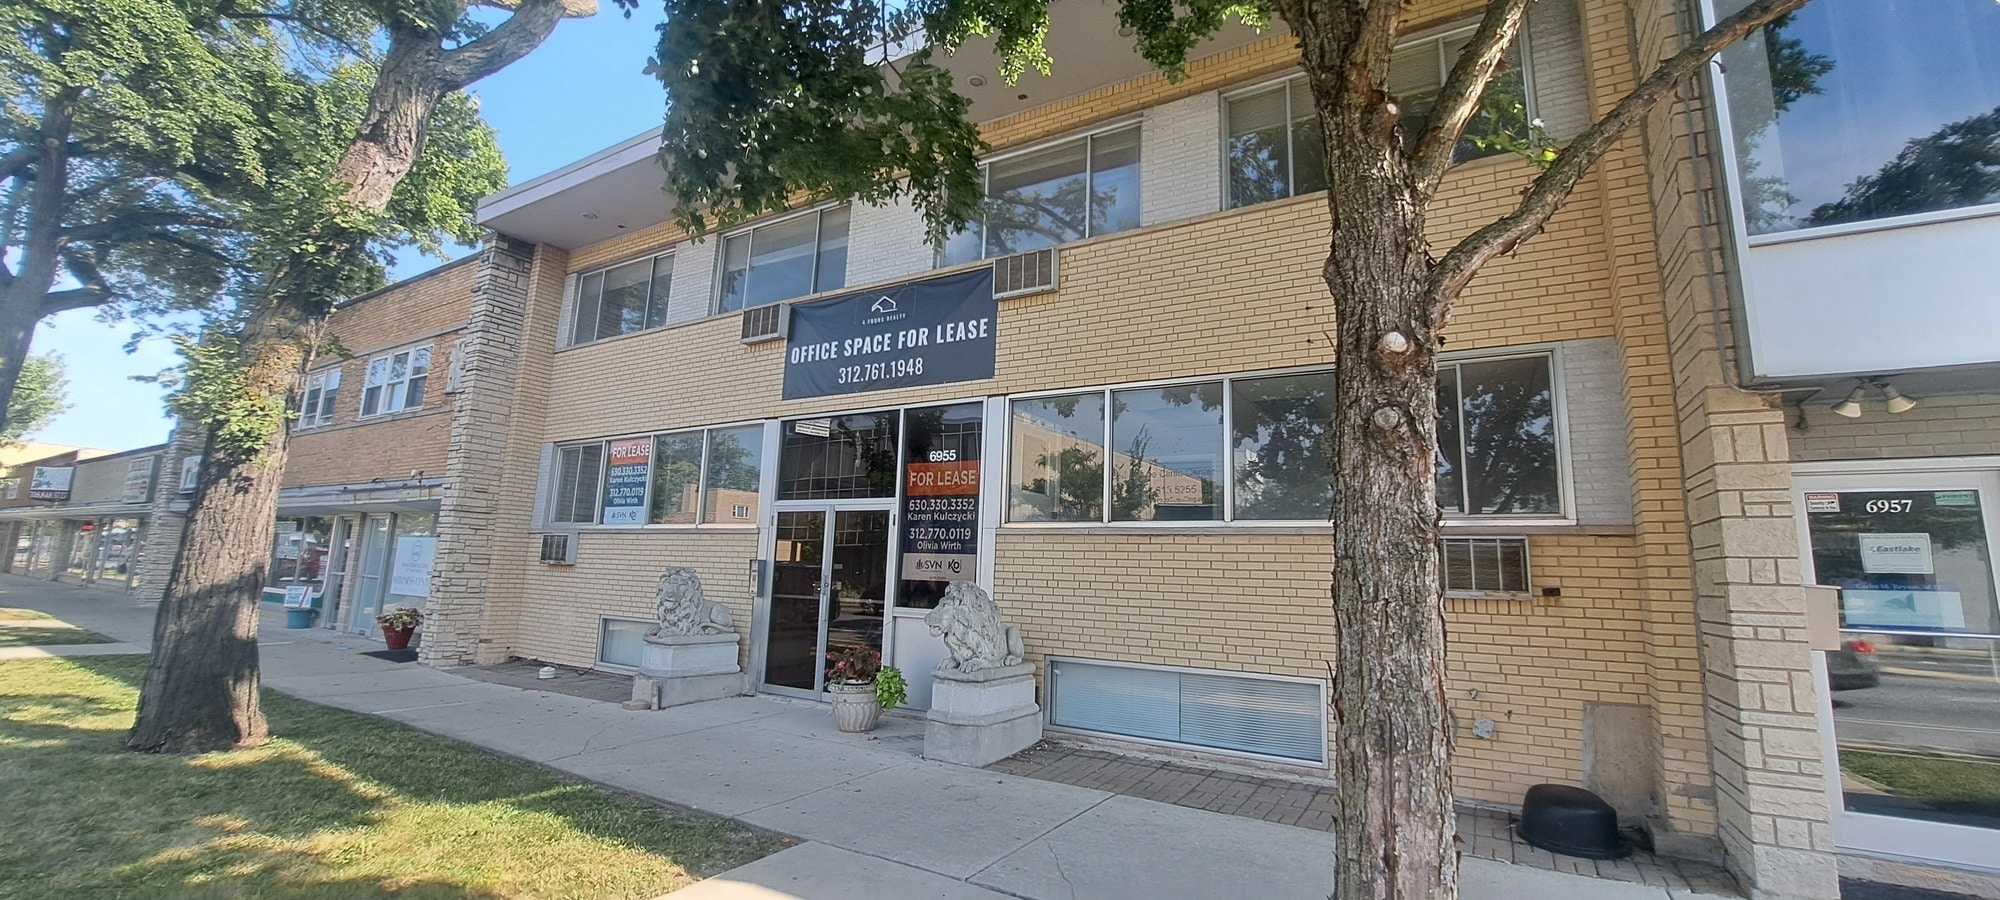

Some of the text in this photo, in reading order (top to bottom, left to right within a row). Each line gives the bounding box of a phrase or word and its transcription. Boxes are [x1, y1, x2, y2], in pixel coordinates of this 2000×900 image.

[886, 313, 906, 322] REALTY
[791, 318, 989, 364] OFFICE SPACE FOR LEASE
[838, 357, 924, 384] 312.761.1948
[612, 444, 650, 458] FOR LEASE
[929, 450, 957, 462] 6955
[609, 476, 623, 484] Karen
[909, 469, 976, 486] FOR LEASE
[609, 487, 645, 498] 312.770.0119
[613, 497, 626, 505] Olivia
[909, 498, 975, 511] 630.330.3352
[1865, 499, 1913, 514] 6957
[907, 511, 976, 522] Karen Kulczycki
[909, 527, 971, 540] 312.770.0119
[917, 540, 962, 550] Olivia Wirth
[1876, 545, 1921, 553] Eastlake
[925, 560, 943, 569] SVN
